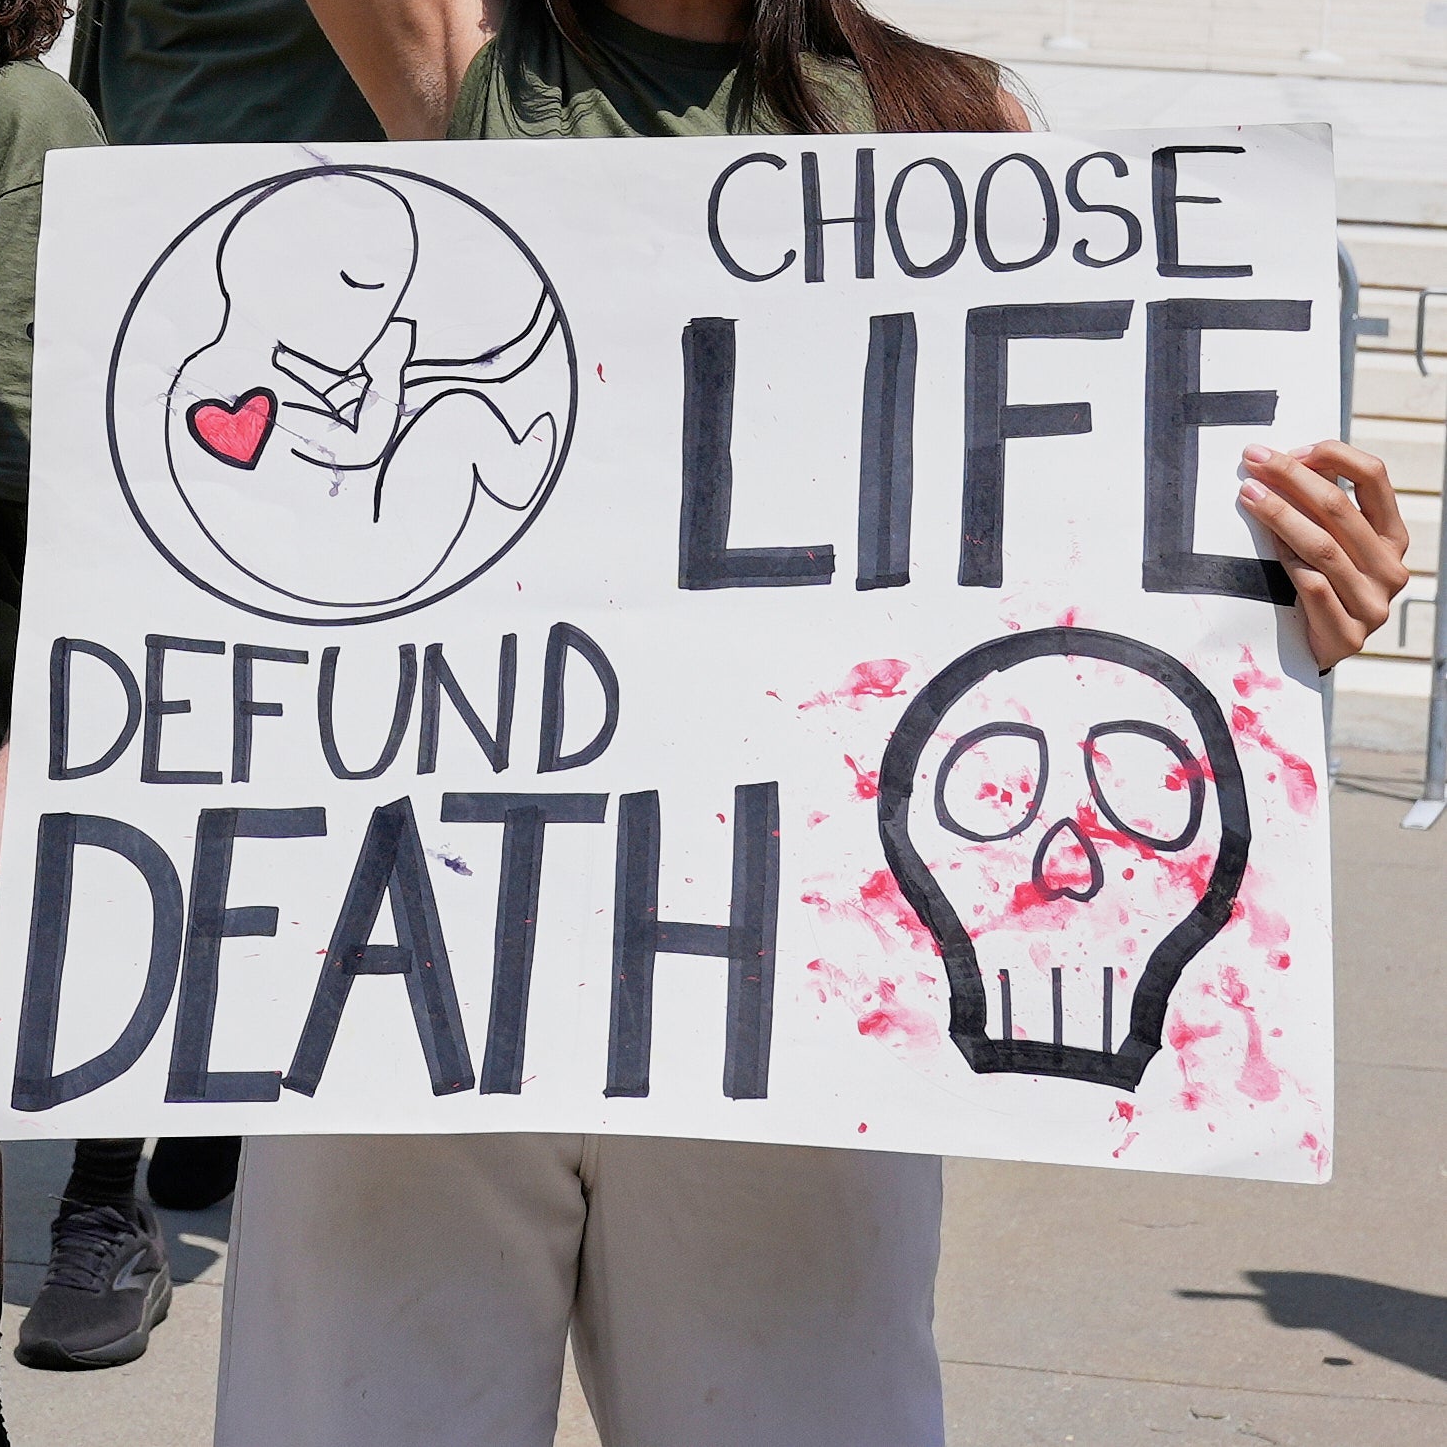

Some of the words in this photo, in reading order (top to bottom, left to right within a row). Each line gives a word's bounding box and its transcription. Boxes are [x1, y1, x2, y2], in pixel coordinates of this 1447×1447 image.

[707, 146, 1254, 284] CHOOSE
[677, 298, 1314, 607] LIFE
[49, 621, 620, 785] DEFUND
[10, 779, 780, 1111] DEATH
